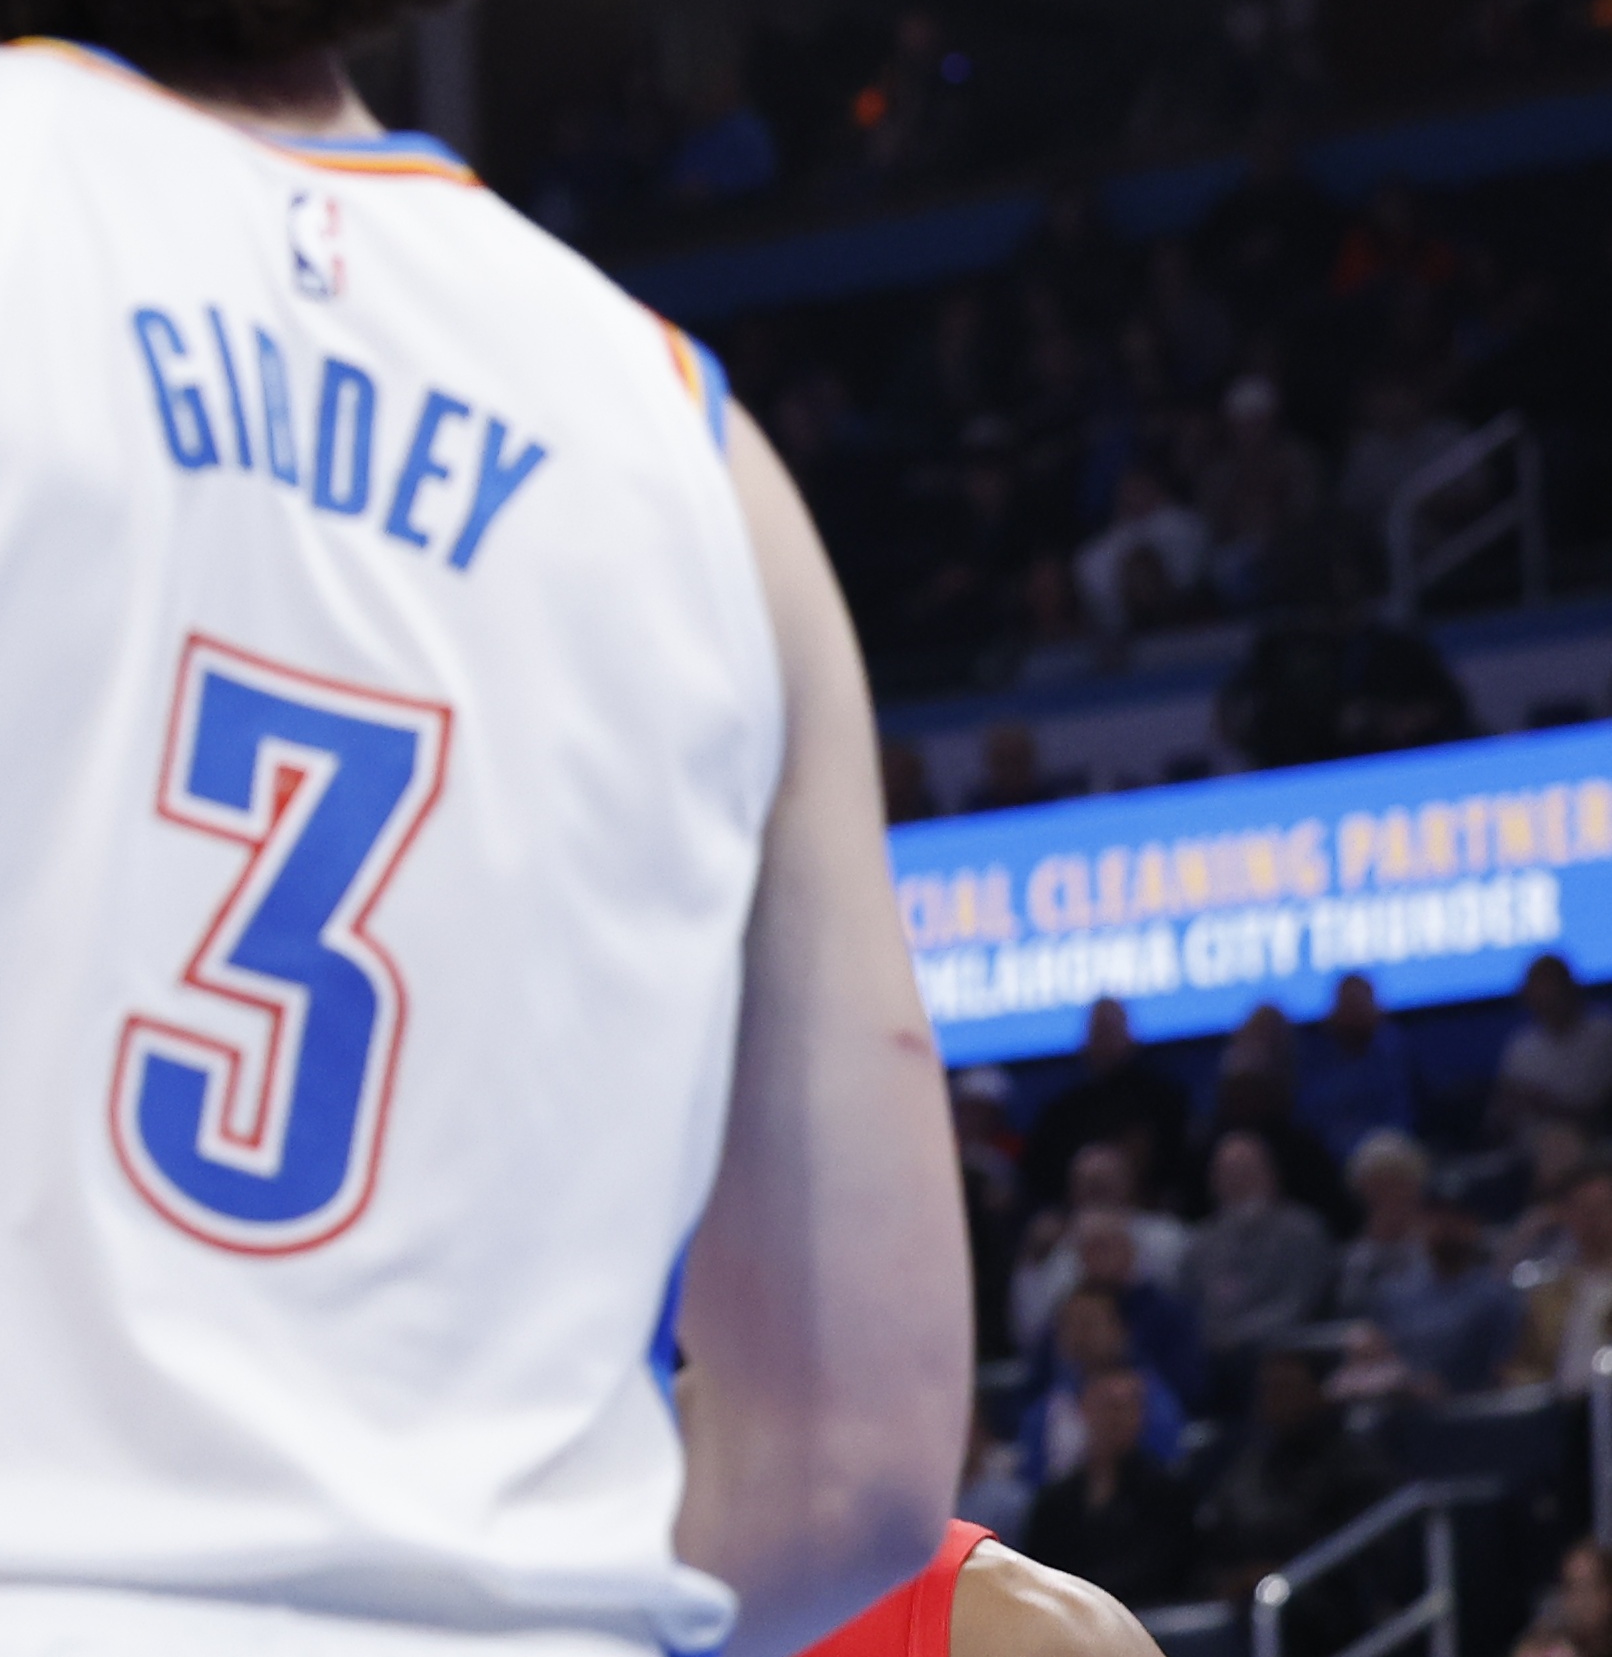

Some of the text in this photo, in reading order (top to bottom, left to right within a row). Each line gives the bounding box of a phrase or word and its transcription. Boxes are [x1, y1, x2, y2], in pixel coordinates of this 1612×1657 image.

[1028, 822, 1329, 928] CLEANING
[1183, 904, 1298, 988] CITY
[1312, 870, 1561, 970] THUNDER
[107, 629, 455, 1259] 3
